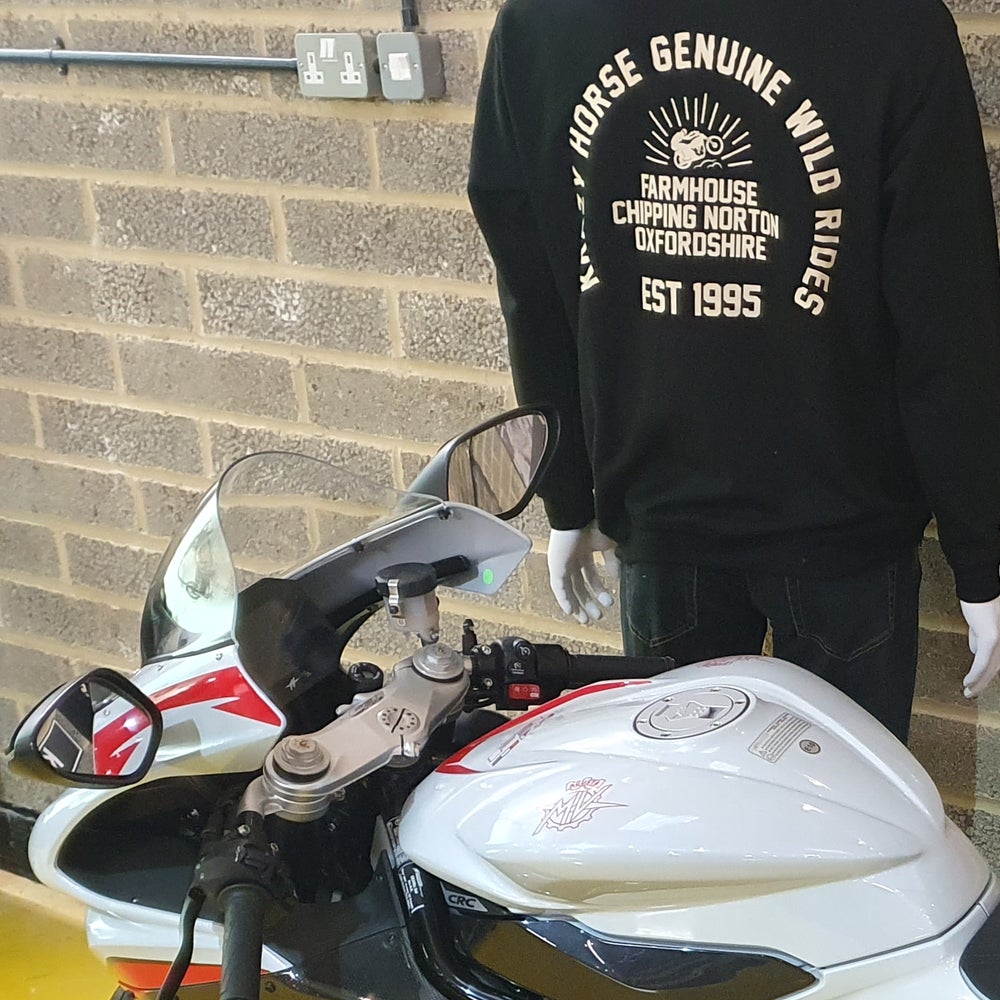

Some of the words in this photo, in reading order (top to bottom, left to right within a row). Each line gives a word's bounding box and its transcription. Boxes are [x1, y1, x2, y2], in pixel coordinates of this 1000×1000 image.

[649, 31, 791, 106] GENUINE
[569, 48, 643, 158] HORSE
[784, 98, 842, 195] WILD
[640, 173, 758, 206] FARMHOUSE
[611, 200, 697, 229] CHIPPING
[703, 204, 780, 239] NORTON
[634, 226, 767, 260] OXFORDSHIRE
[794, 208, 843, 316] RIDES
[641, 276, 682, 315] EST
[692, 282, 762, 318] 1995
[448, 894, 476, 908] CRC
